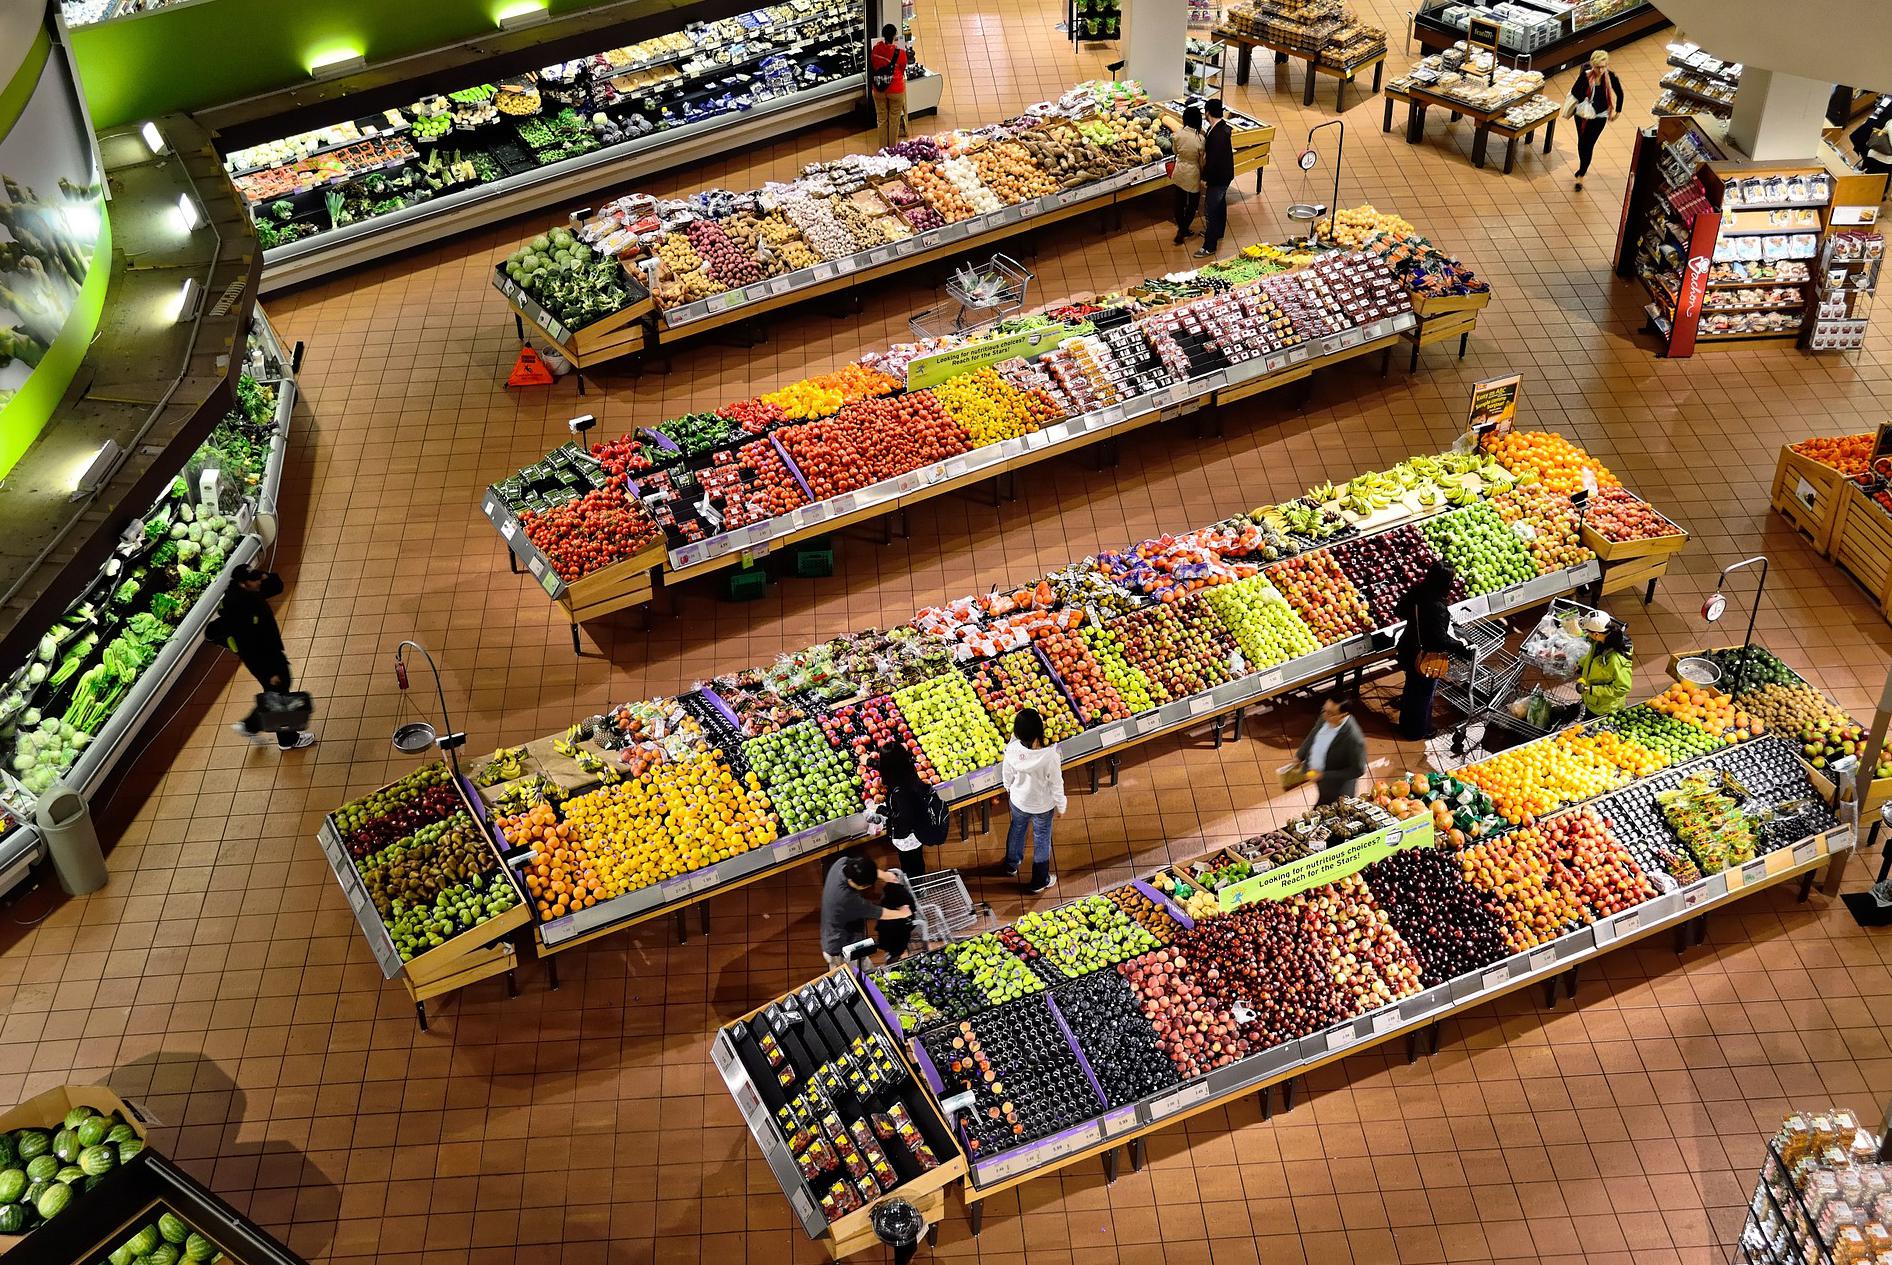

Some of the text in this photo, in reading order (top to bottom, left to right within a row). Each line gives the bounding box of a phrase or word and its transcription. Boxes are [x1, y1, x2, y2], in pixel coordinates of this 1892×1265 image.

[1687, 256, 1710, 317] Vachon
[936, 337, 1026, 364] Looking for nutritious choices?
[952, 357, 970, 366] Reach
[992, 347, 1010, 357] Stars!
[1476, 393, 1489, 402] Easy
[1259, 837, 1381, 888] Looking for nutritious choices?
[1281, 852, 1361, 888] Reach for the Stars!
